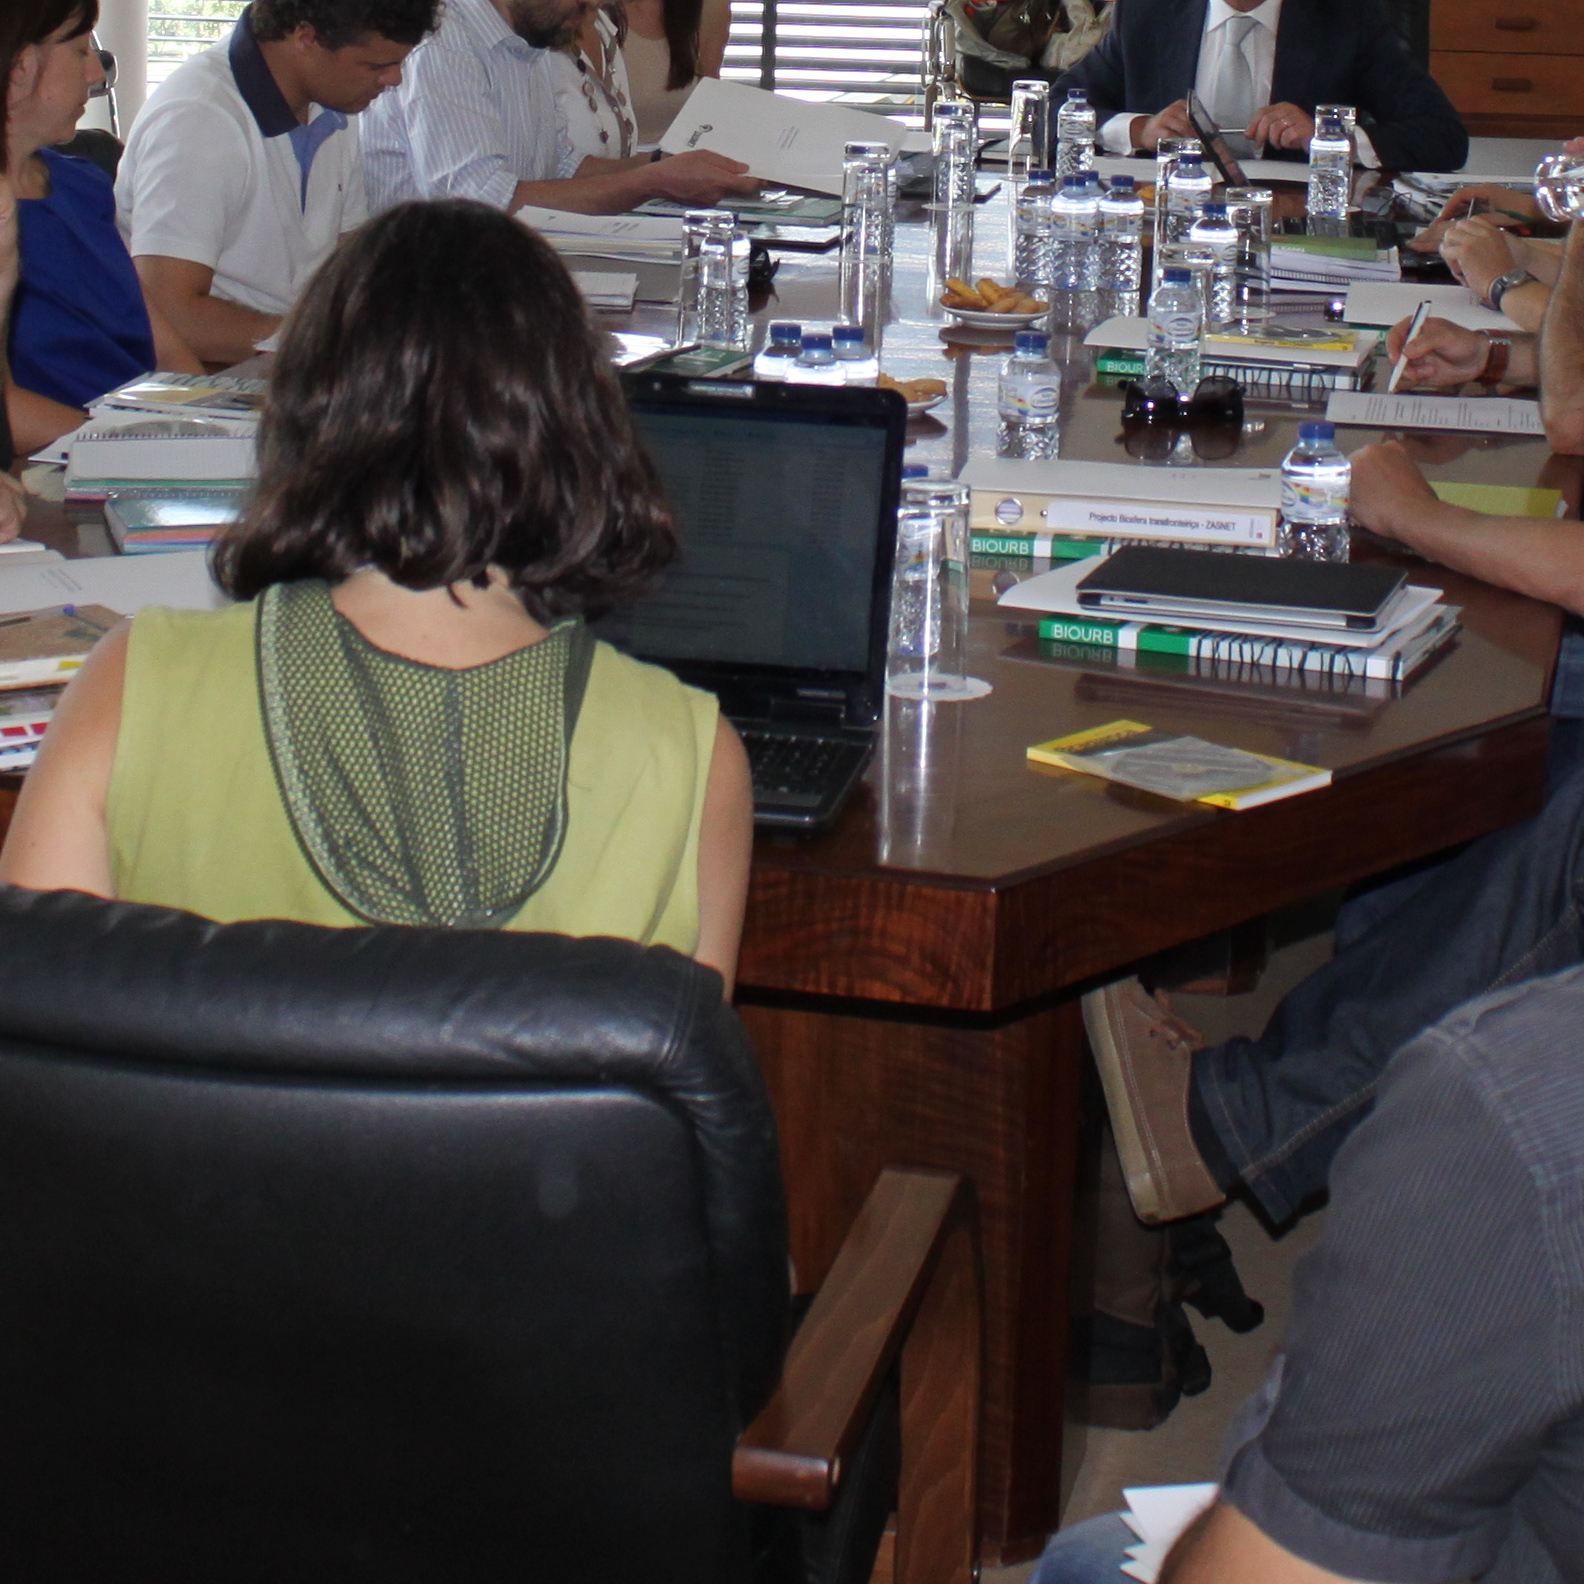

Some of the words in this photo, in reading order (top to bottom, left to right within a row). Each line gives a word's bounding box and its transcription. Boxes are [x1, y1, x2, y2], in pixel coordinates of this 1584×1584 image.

[1107, 361, 1144, 373] BIOUR
[1089, 511, 1118, 523] Projecto
[1119, 514, 1147, 525] Biosfera
[972, 539, 1029, 555] BIOURB
[1053, 624, 1113, 644] BIOURB
